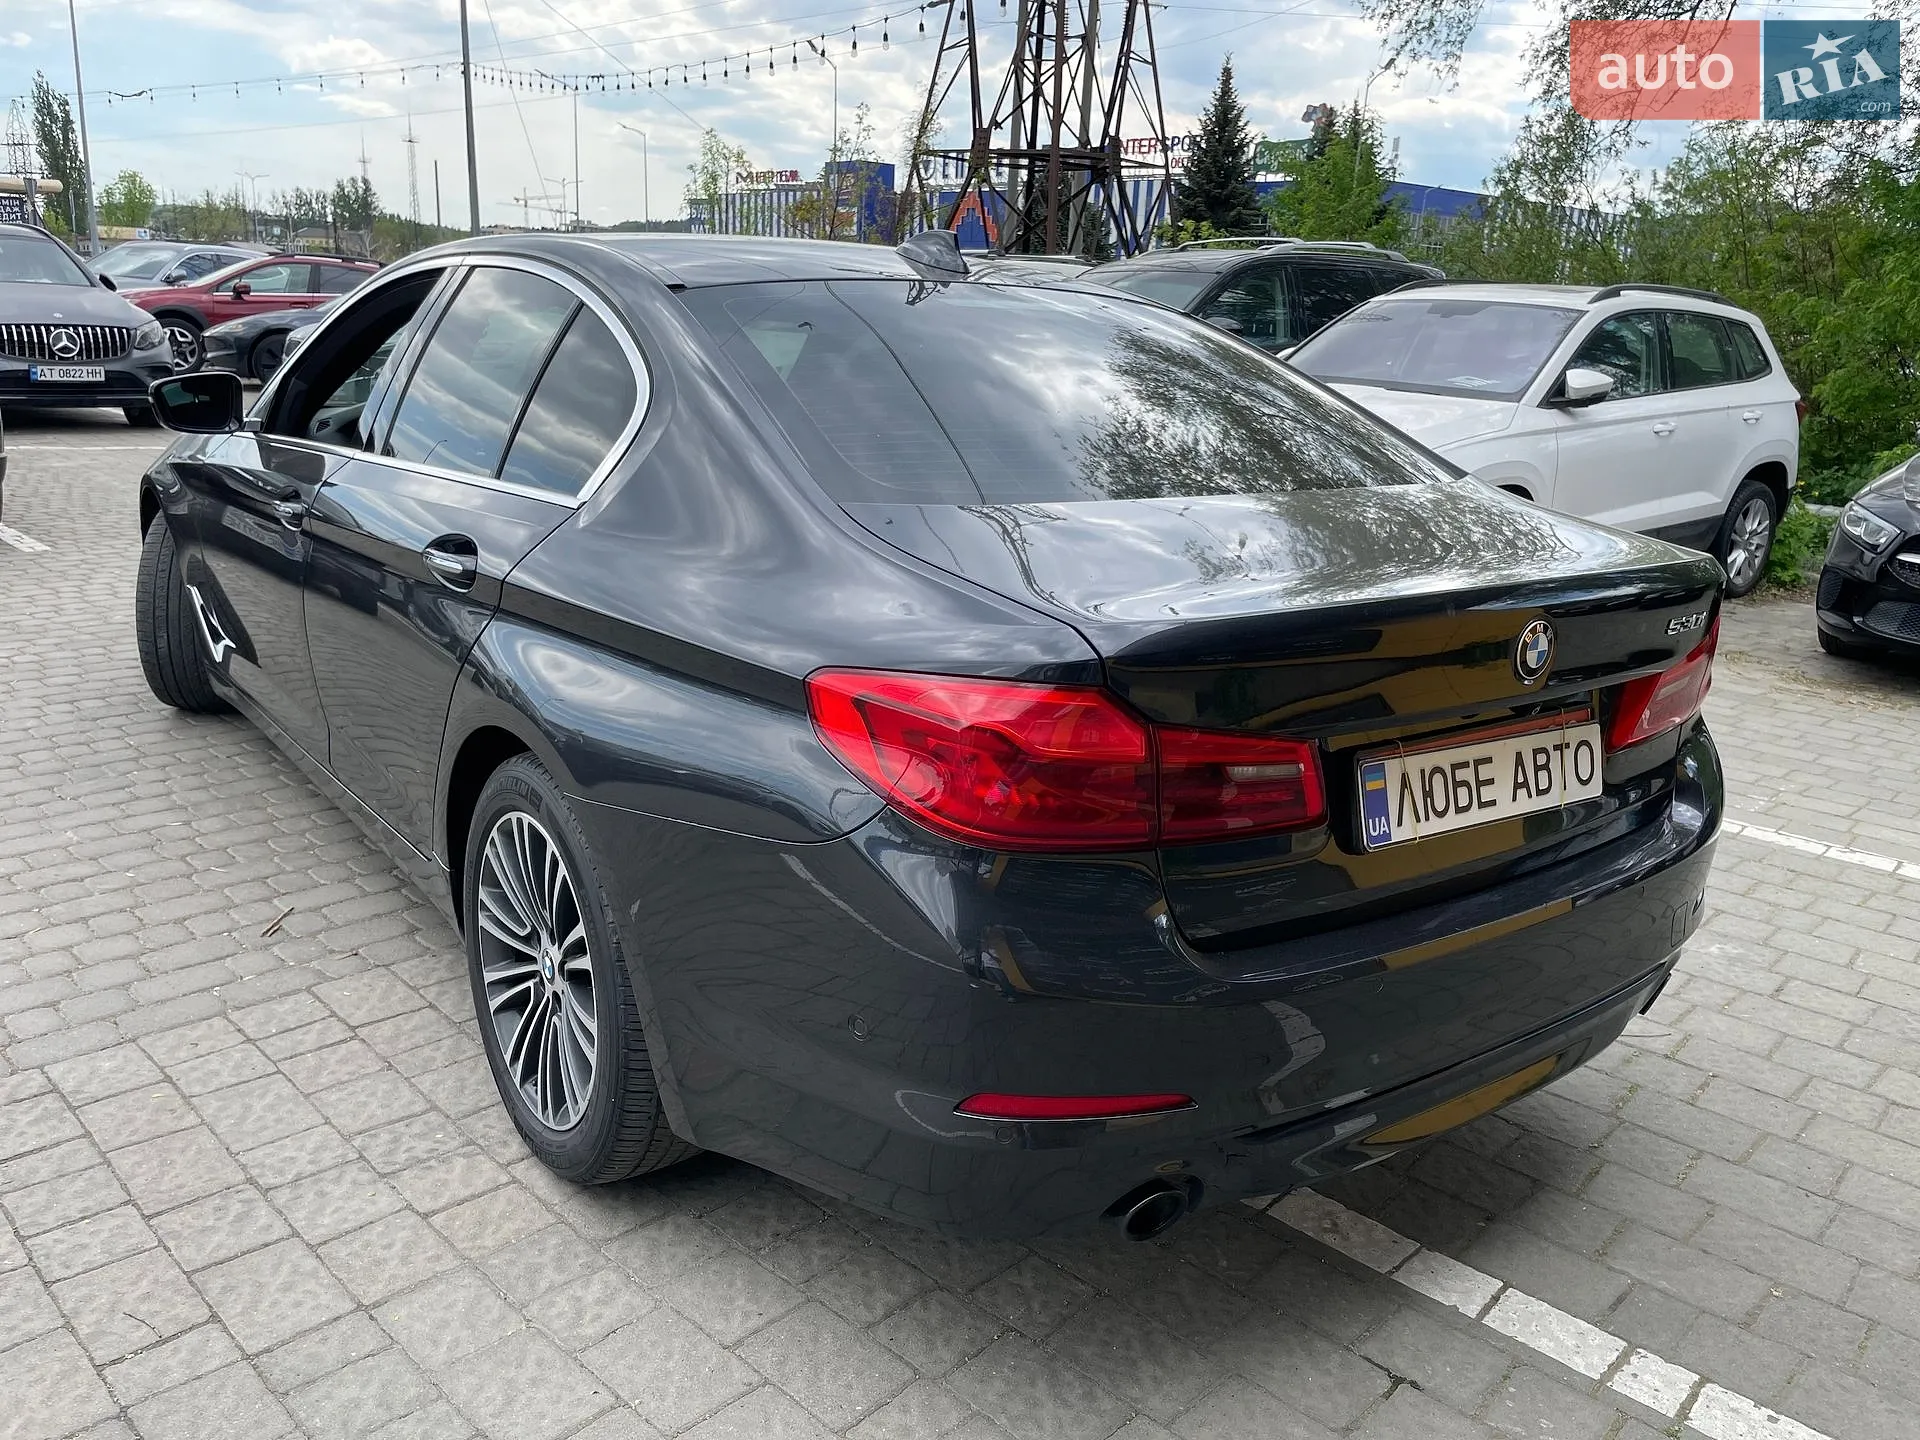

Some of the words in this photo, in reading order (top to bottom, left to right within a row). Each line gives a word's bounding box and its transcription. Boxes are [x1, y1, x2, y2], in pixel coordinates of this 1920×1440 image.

[39, 368, 55, 379] AT
[58, 368, 84, 379] 0822
[86, 368, 102, 379] HH
[1397, 756, 1497, 827] ЛЮБЕ
[1511, 739, 1595, 802] АВТО
[1368, 817, 1390, 837] UA
